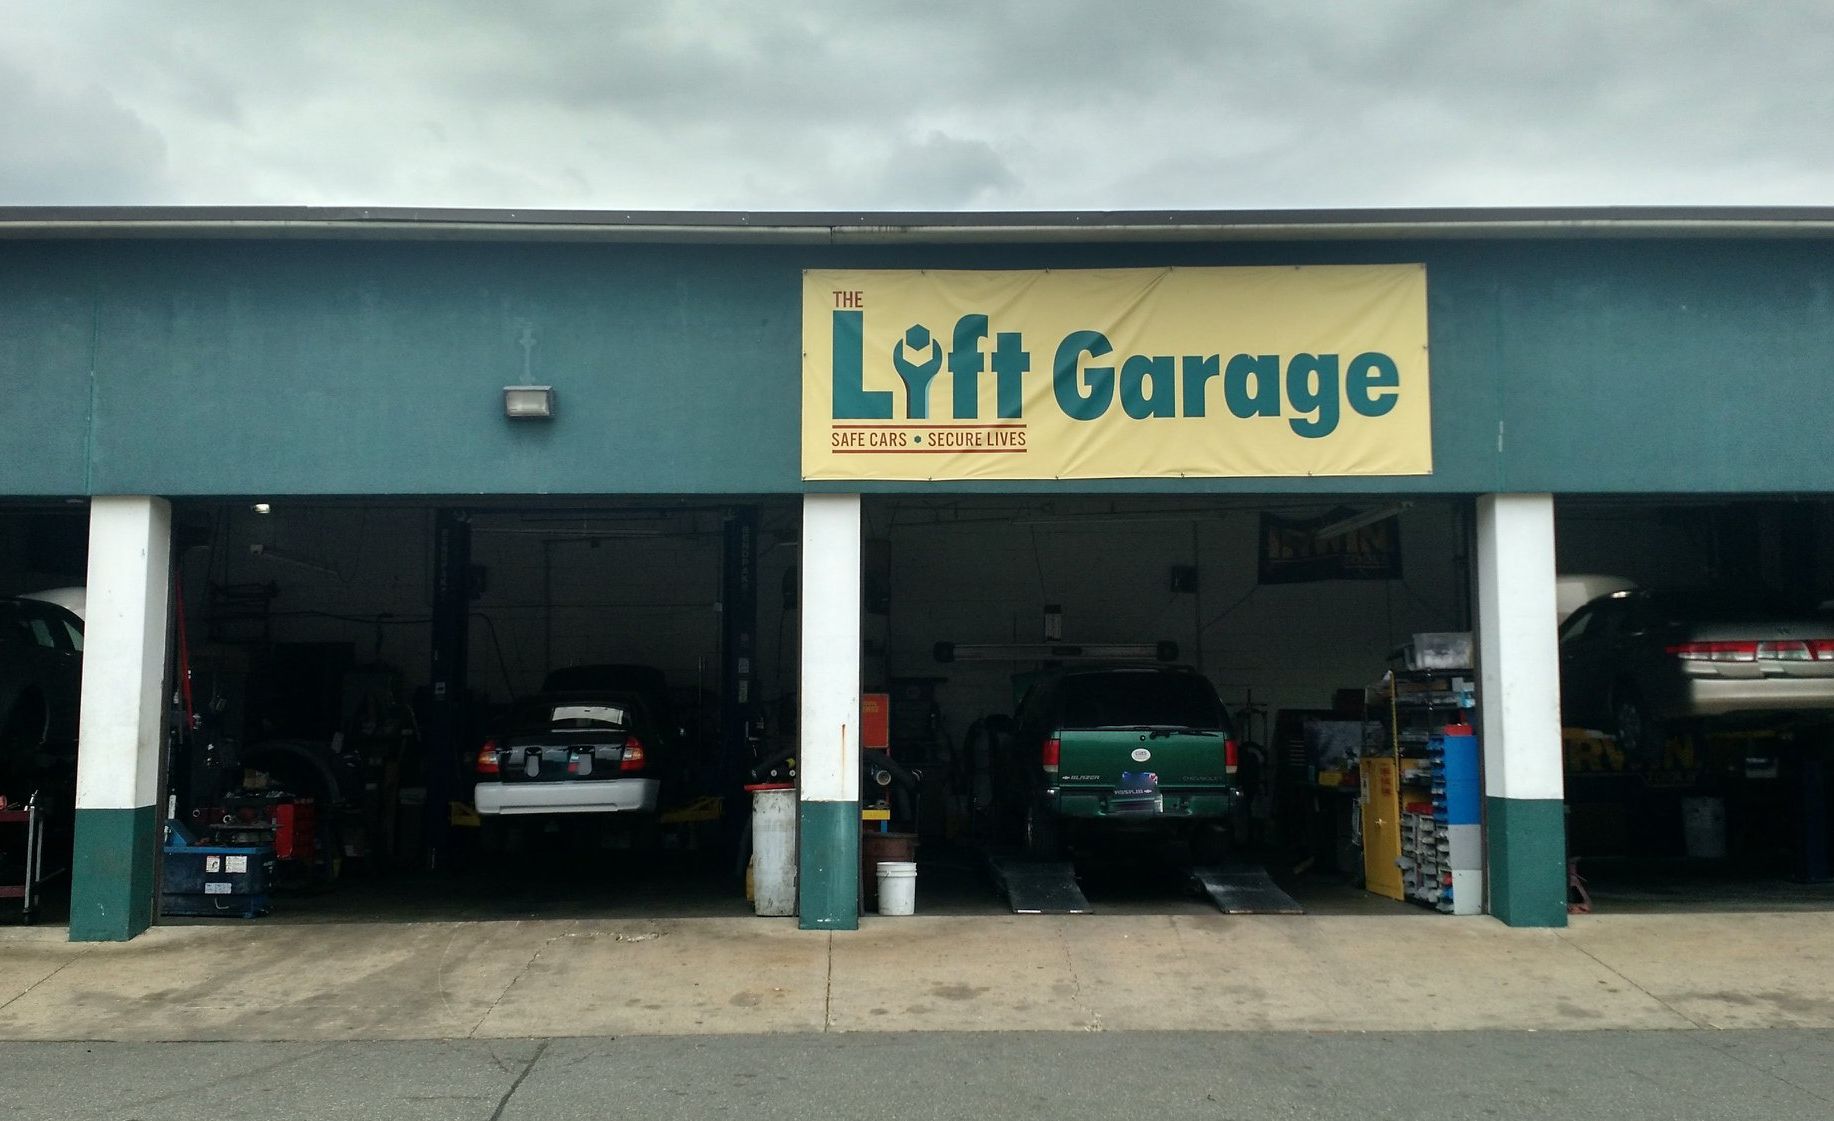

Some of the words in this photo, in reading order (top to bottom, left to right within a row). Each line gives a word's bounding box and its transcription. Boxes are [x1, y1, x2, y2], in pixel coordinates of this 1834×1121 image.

[833, 291, 864, 308] THE
[832, 310, 1031, 419] Lift
[1052, 330, 1400, 439] Garage
[831, 432, 865, 447] SAFE
[869, 432, 907, 447] CARS
[928, 432, 982, 447] SECURE
[987, 431, 1026, 446] LIVES
